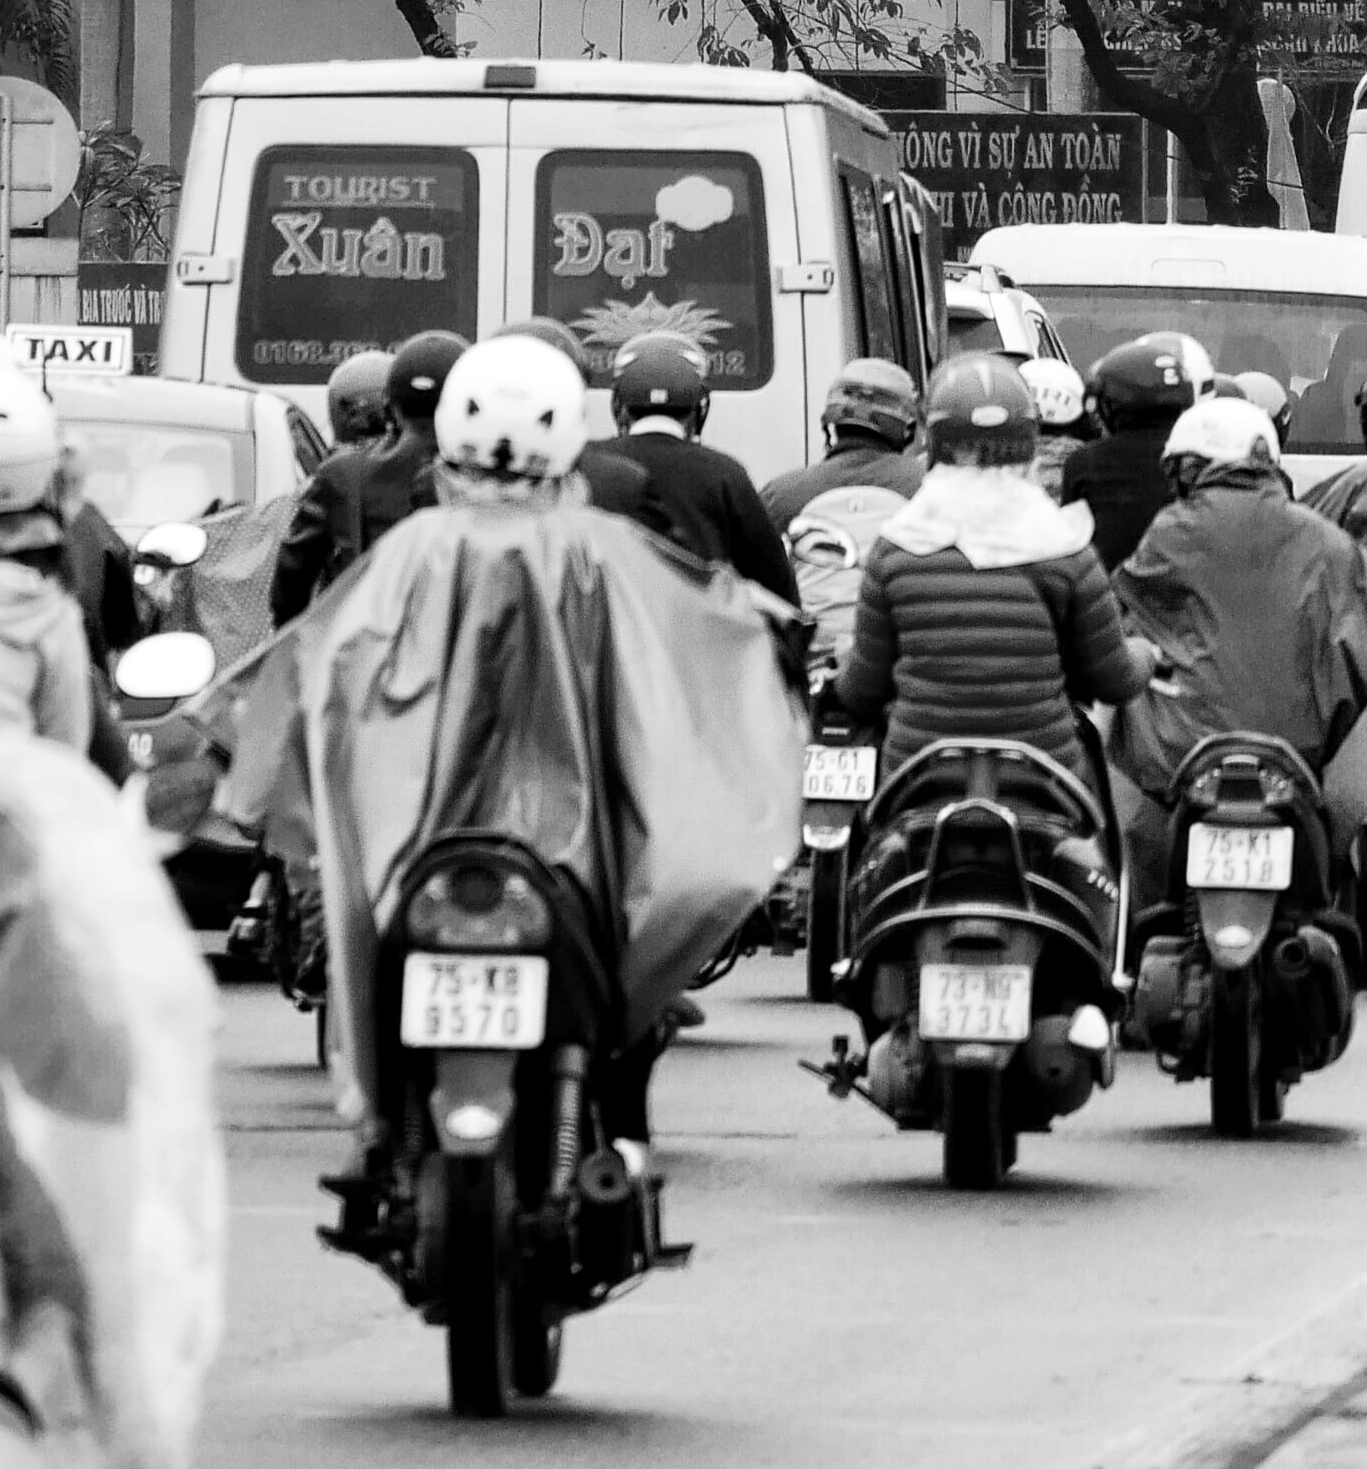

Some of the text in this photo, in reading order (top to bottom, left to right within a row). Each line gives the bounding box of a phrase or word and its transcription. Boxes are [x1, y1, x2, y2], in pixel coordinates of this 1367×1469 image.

[958, 121, 982, 169] VÌ
[988, 124, 1021, 179] SỰ
[1023, 133, 1055, 170] AN
[1060, 122, 1122, 171] TOÀN
[282, 174, 437, 204] TOURIST
[961, 181, 992, 229] VÀ
[271, 211, 447, 281] Xuân
[148, 290, 165, 324] TR
[27, 338, 112, 362] TAXI
